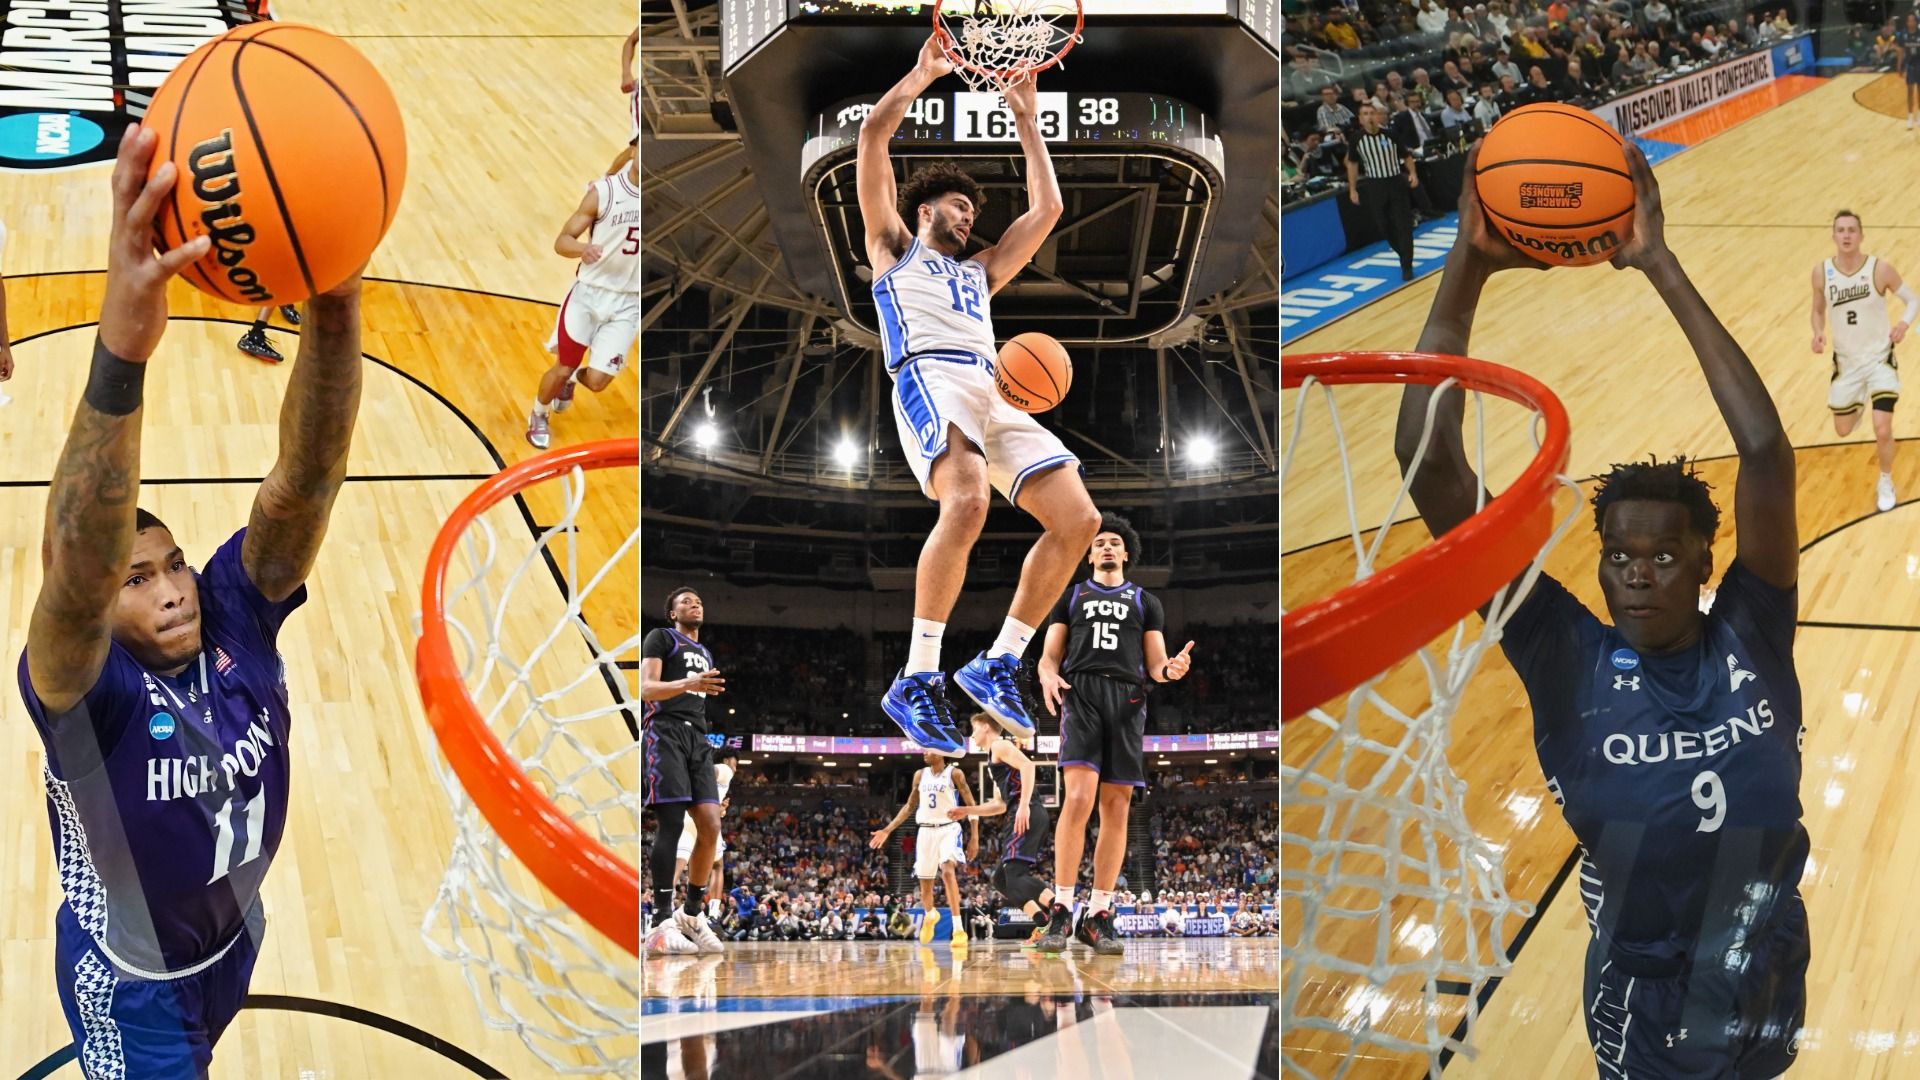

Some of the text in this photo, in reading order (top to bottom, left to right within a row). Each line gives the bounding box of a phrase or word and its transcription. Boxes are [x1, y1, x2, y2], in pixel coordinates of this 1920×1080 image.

[1615, 54, 1769, 136] MISSOURI VALLEY CONFERENCE
[903, 98, 945, 125] 40
[1078, 98, 1119, 125] 38
[36, 113, 71, 155] NCAA
[187, 128, 274, 302] Wilson
[622, 226, 639, 255] 5
[1504, 226, 1620, 259] Wilson
[947, 278, 984, 322] 12
[1829, 283, 1870, 306] Purdue
[1847, 310, 1858, 325] 2
[1083, 600, 1130, 621] TCU
[1092, 621, 1120, 651] 15
[683, 651, 710, 673] TCU
[1614, 656, 1638, 665] NCAA
[1602, 699, 1775, 765] QUEENS
[147, 755, 218, 801] HIGH
[922, 783, 946, 793] DUKE
[928, 793, 937, 809] 3
[1691, 769, 1727, 833] 9
[206, 781, 266, 887] 11
[1121, 914, 1160, 931] DEFENSE
[1186, 918, 1225, 936] DEFENSE
